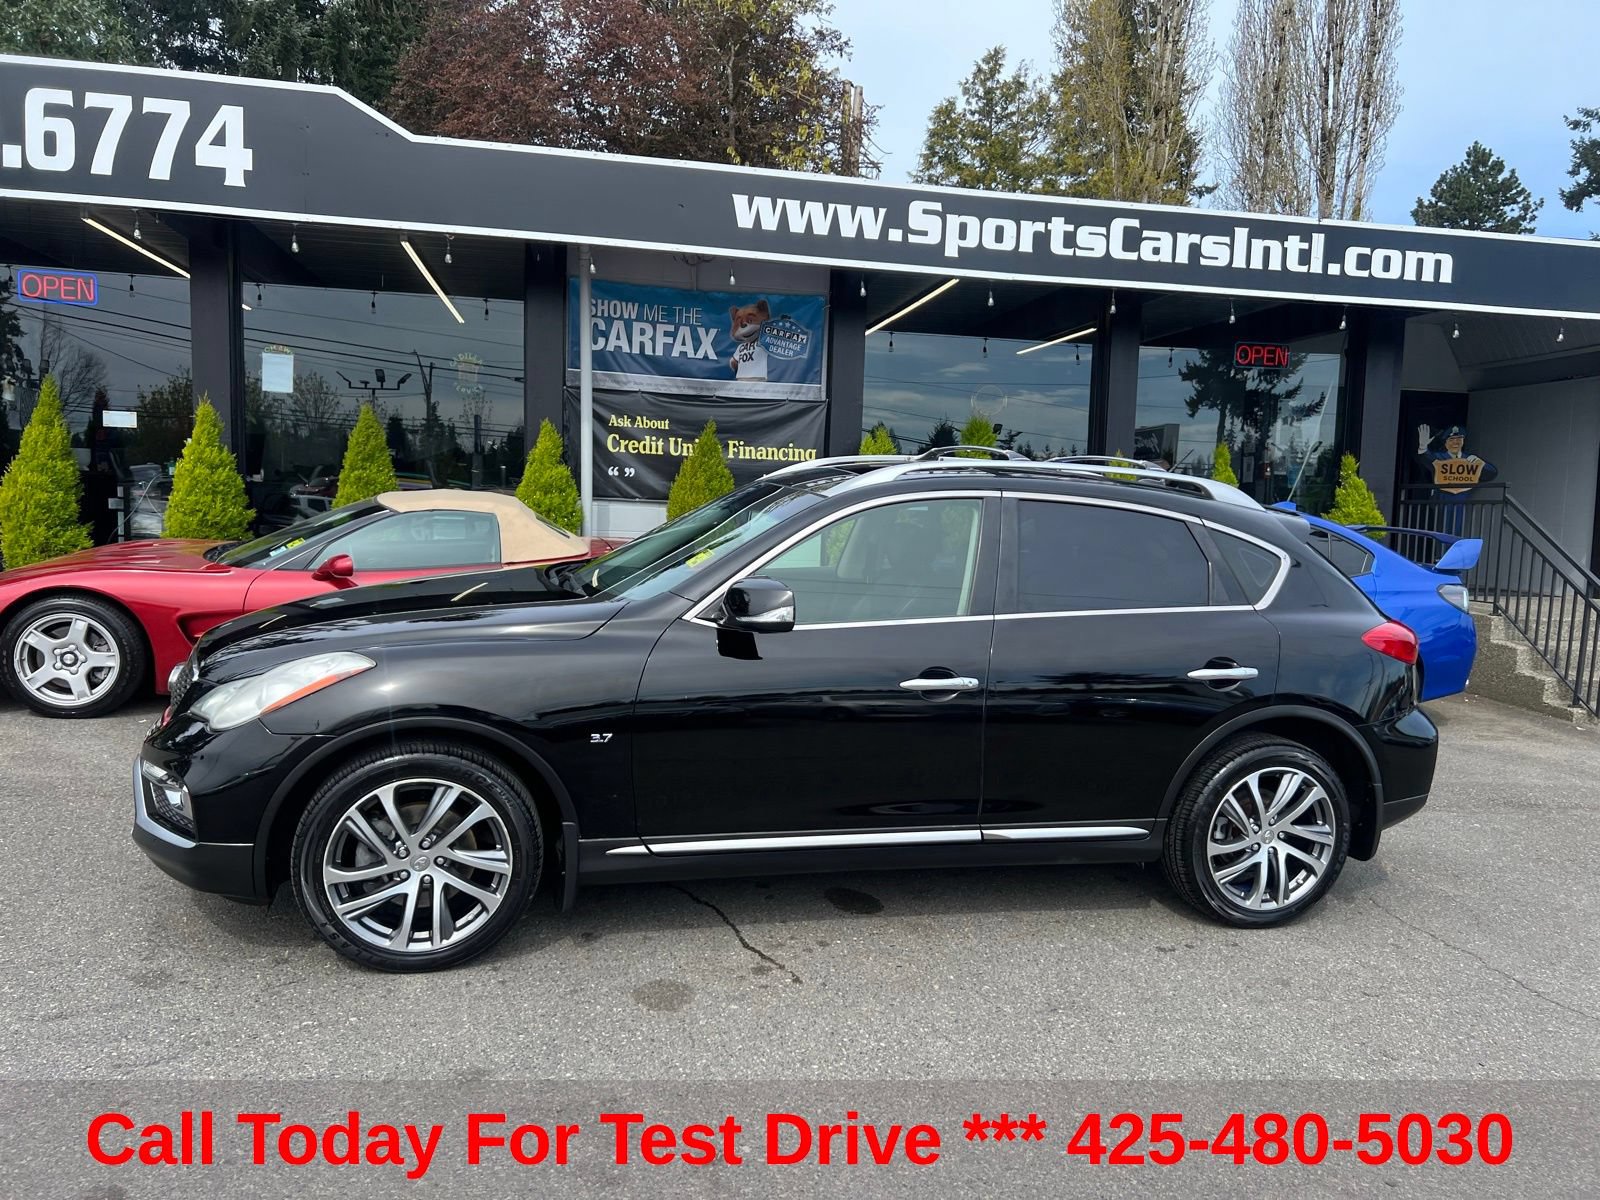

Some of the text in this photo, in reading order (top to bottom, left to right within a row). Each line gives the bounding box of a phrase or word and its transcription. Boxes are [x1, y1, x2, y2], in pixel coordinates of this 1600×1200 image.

[2, 87, 253, 188] .6774
[731, 193, 1454, 284] www.SportsCarsIntl.com
[22, 273, 95, 302] OPEN
[591, 298, 703, 326] SHOW ME THE
[591, 317, 718, 360] CARFAX
[764, 326, 807, 344] CARFAX
[765, 336, 802, 352] ADVANTAGE
[738, 351, 755, 363] FOX
[768, 345, 794, 357] DEALER
[1236, 345, 1289, 368] OPEN
[608, 414, 670, 430] Ask About
[606, 434, 817, 462] Credit Uni Financing
[1440, 463, 1479, 476] SLOW
[590, 733, 613, 743] 3.7
